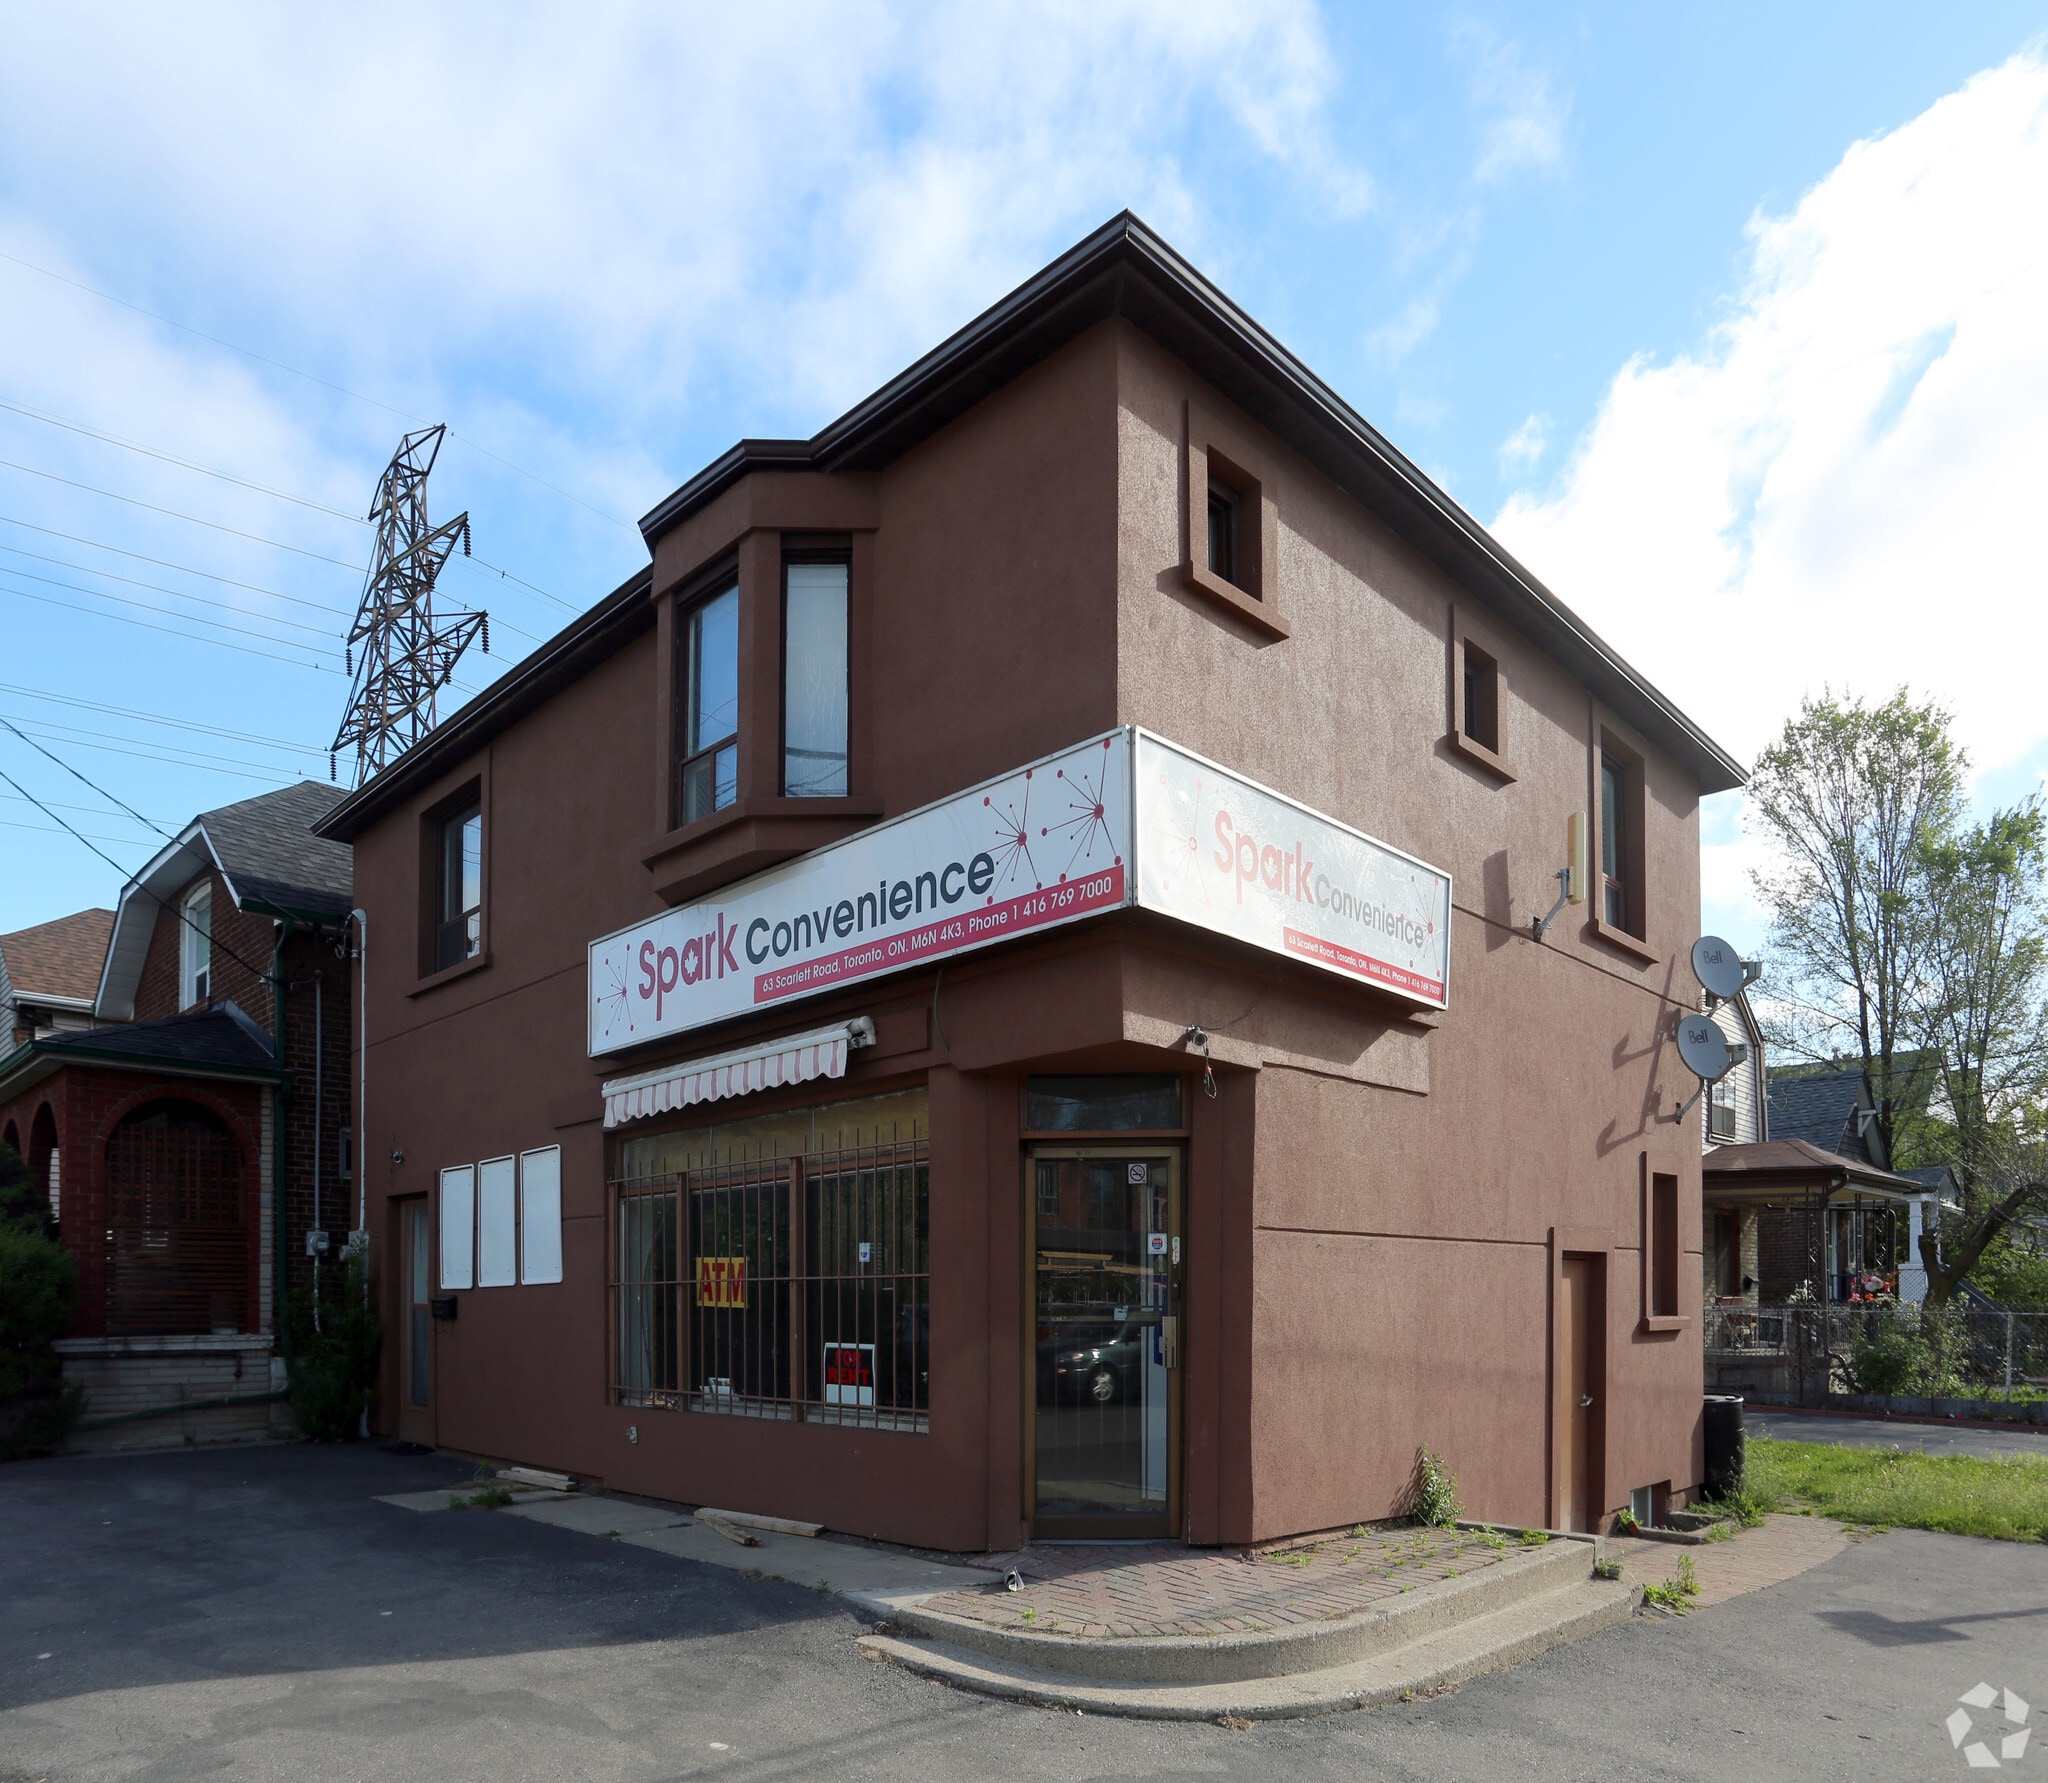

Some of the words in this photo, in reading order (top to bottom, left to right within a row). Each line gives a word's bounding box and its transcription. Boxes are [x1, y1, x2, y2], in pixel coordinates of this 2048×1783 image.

[1213, 810, 1314, 905] Spark
[1314, 873, 1424, 950] Convenience
[638, 912, 738, 1022] Spark
[745, 852, 994, 965] Convenience
[762, 977, 774, 992] 63
[775, 966, 811, 989] Scarlett
[813, 959, 841, 979] Road,
[843, 948, 885, 970] Toronto,
[888, 938, 909, 957] ON.
[911, 929, 937, 950] M6N
[940, 922, 965, 941] 4K3,
[969, 911, 1008, 933] Phone
[1013, 904, 1018, 920] 1
[1023, 896, 1046, 917] 416
[1051, 887, 1075, 909] 769
[1079, 876, 1112, 901] 7000
[1703, 950, 1723, 965] Bell
[1288, 934, 1296, 945] 63
[1296, 937, 1319, 953] Scarlett
[1319, 944, 1336, 960] Road,
[1336, 950, 1358, 968] Toronto,
[1392, 971, 1407, 984] Phone
[1411, 978, 1420, 989] 416
[1429, 983, 1440, 996] 7000
[1688, 1029, 1709, 1045] Bell
[698, 1262, 746, 1303] ATM
[827, 1366, 870, 1386] RENT
